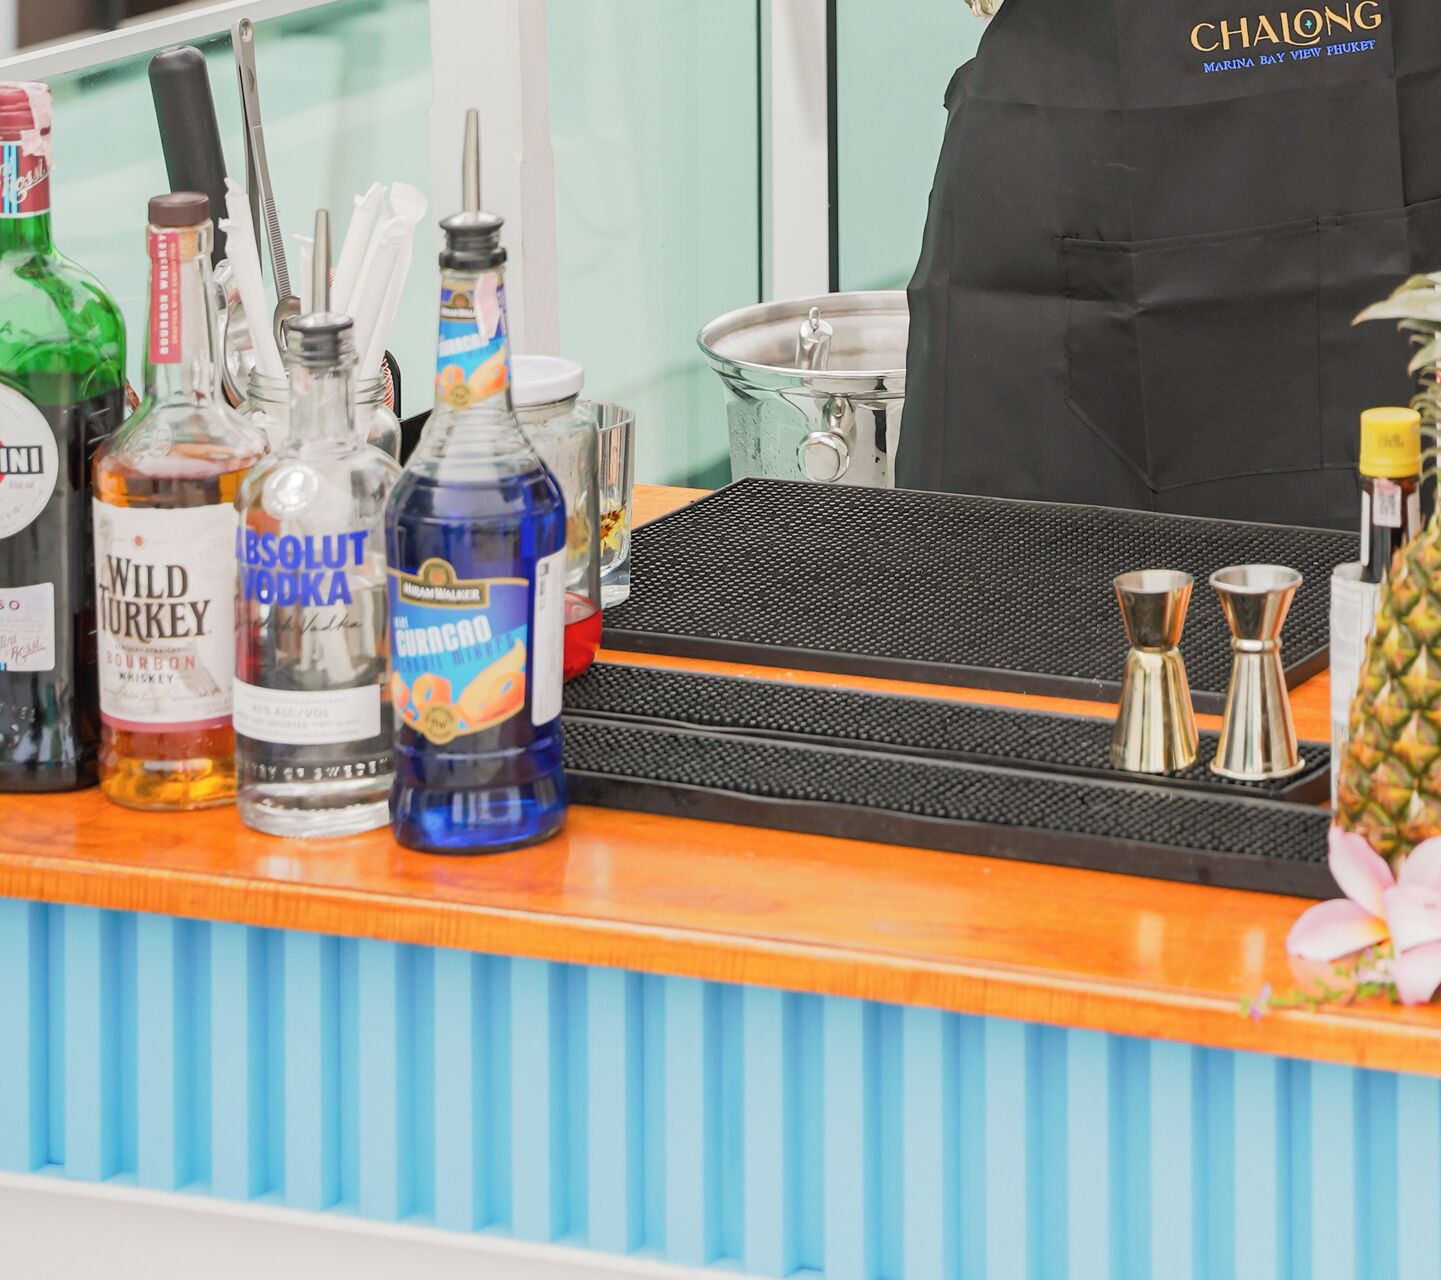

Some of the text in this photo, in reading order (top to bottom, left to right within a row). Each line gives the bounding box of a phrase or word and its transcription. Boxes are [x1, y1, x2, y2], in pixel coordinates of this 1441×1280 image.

[1190, 0, 1382, 52] CHALONG
[1203, 40, 1376, 74] MARINA BAY VIEW PHUKET
[236, 526, 369, 570] ABSOLUT
[106, 554, 188, 599] WILD
[241, 568, 353, 607] VODKA
[99, 583, 211, 643] TURKEY
[107, 651, 196, 670] BOURBON
[118, 672, 174, 684] WHISKEY
